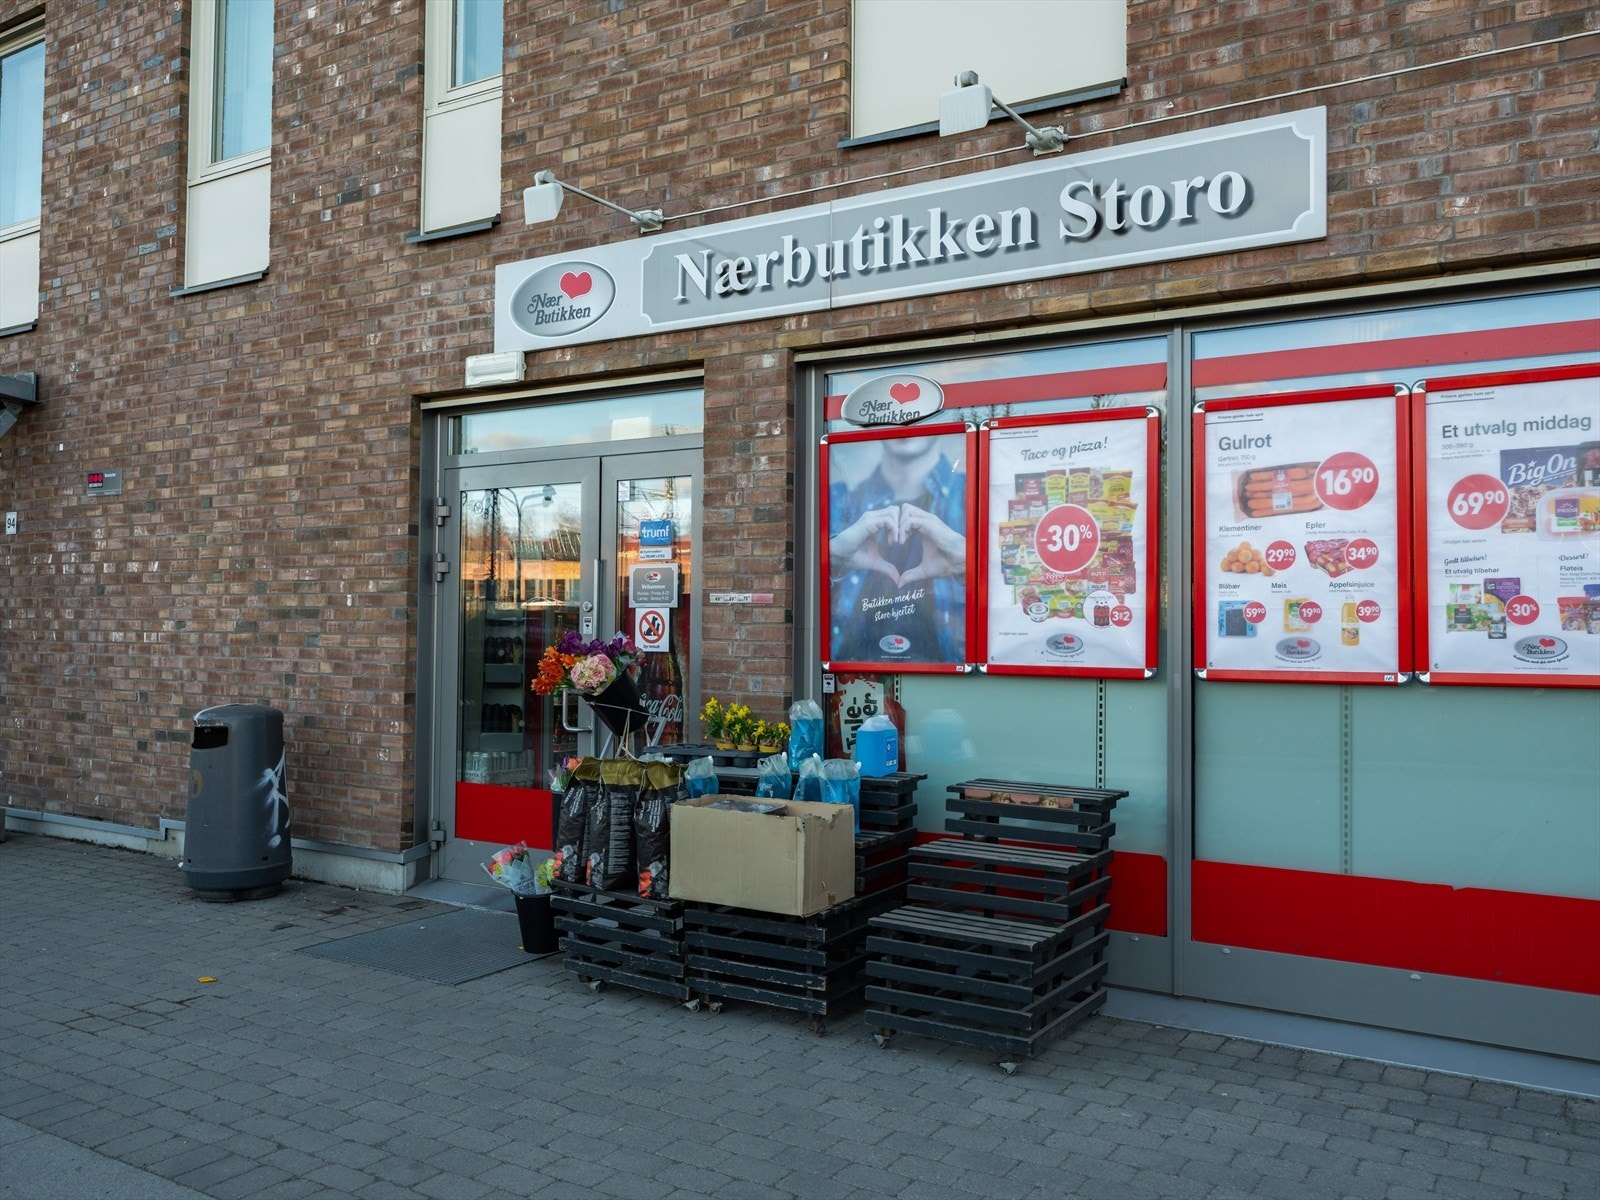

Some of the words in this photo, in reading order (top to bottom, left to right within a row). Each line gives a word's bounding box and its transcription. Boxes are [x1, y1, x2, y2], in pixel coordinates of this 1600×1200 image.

[674, 205, 1037, 304] Nærbutikken
[1058, 168, 1251, 241] Storo
[527, 293, 563, 314] Nær
[535, 305, 591, 326] Butikken
[859, 400, 893, 416] Nær
[868, 410, 920, 424] Butikken
[1442, 425, 1458, 438] Et
[1464, 420, 1517, 437] utvalg
[1524, 415, 1592, 432] middag
[1021, 448, 1048, 461] Taco
[1052, 447, 1066, 460] og
[1070, 436, 1108, 458] pizza!
[1218, 434, 1272, 450] Gulrot
[1508, 463, 1546, 486] Big
[7, 518, 16, 528] 94
[1219, 524, 1262, 533] Klementiner
[1306, 522, 1326, 530] Epler
[641, 526, 670, 538] trumf
[1040, 524, 1092, 552] -30%
[1558, 552, 1589, 562] Dessert!
[1218, 582, 1240, 590] Blåbær
[1328, 581, 1375, 590] Appelsinjuice
[862, 596, 894, 612] Butikken
[894, 591, 912, 604] med
[912, 588, 925, 600] det
[874, 609, 891, 622] store
[892, 604, 916, 620] hjertet
[1112, 611, 1119, 621] 3
[1123, 612, 1130, 621] 2
[1508, 604, 1537, 616] -30%
[862, 692, 878, 718] er
